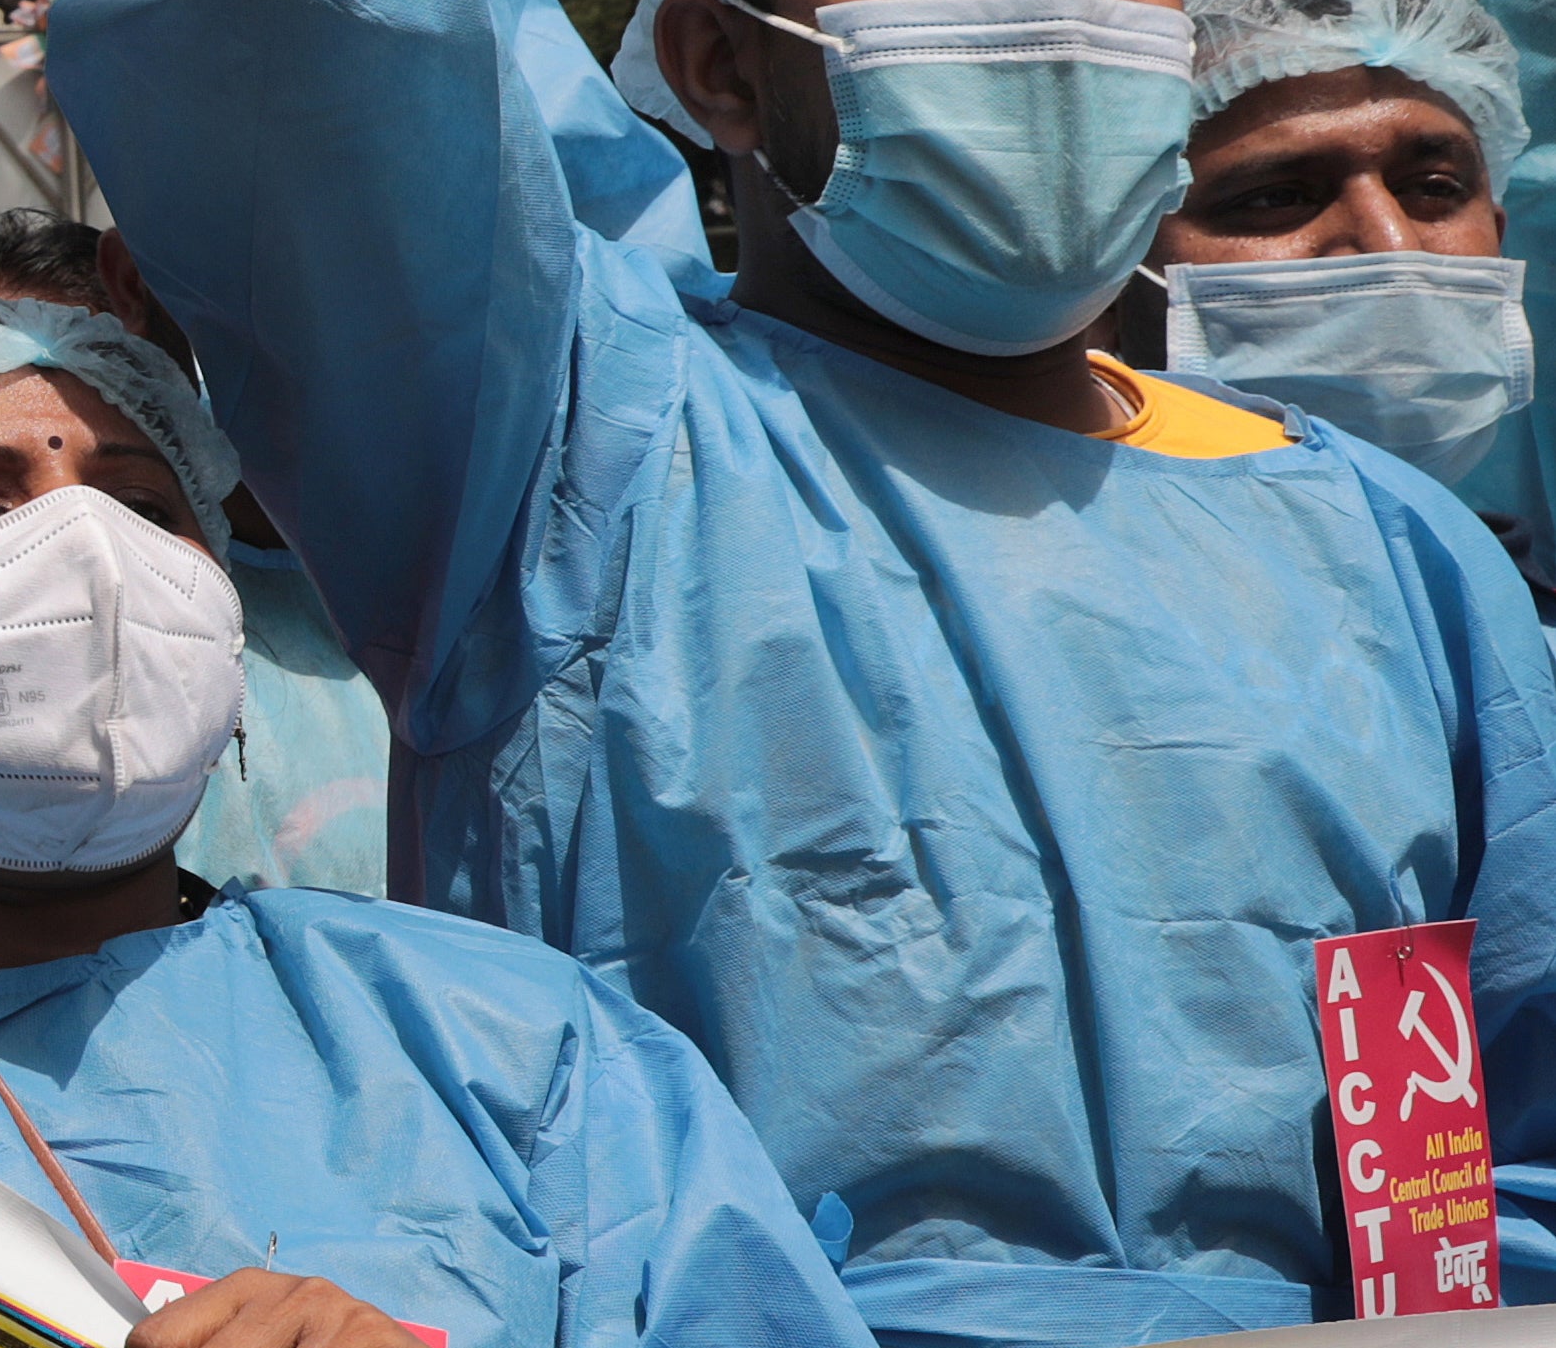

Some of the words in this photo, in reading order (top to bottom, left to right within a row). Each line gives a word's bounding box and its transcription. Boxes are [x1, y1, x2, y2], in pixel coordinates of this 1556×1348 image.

[18, 690, 46, 703] N95
[1425, 1133, 1445, 1160] All
[1448, 1128, 1483, 1153] India
[1389, 1170, 1431, 1204] Central
[1432, 1165, 1473, 1197] Council
[1474, 1158, 1487, 1186] of
[1408, 1203, 1445, 1235] Trade
[1446, 1195, 1489, 1226] Unions
